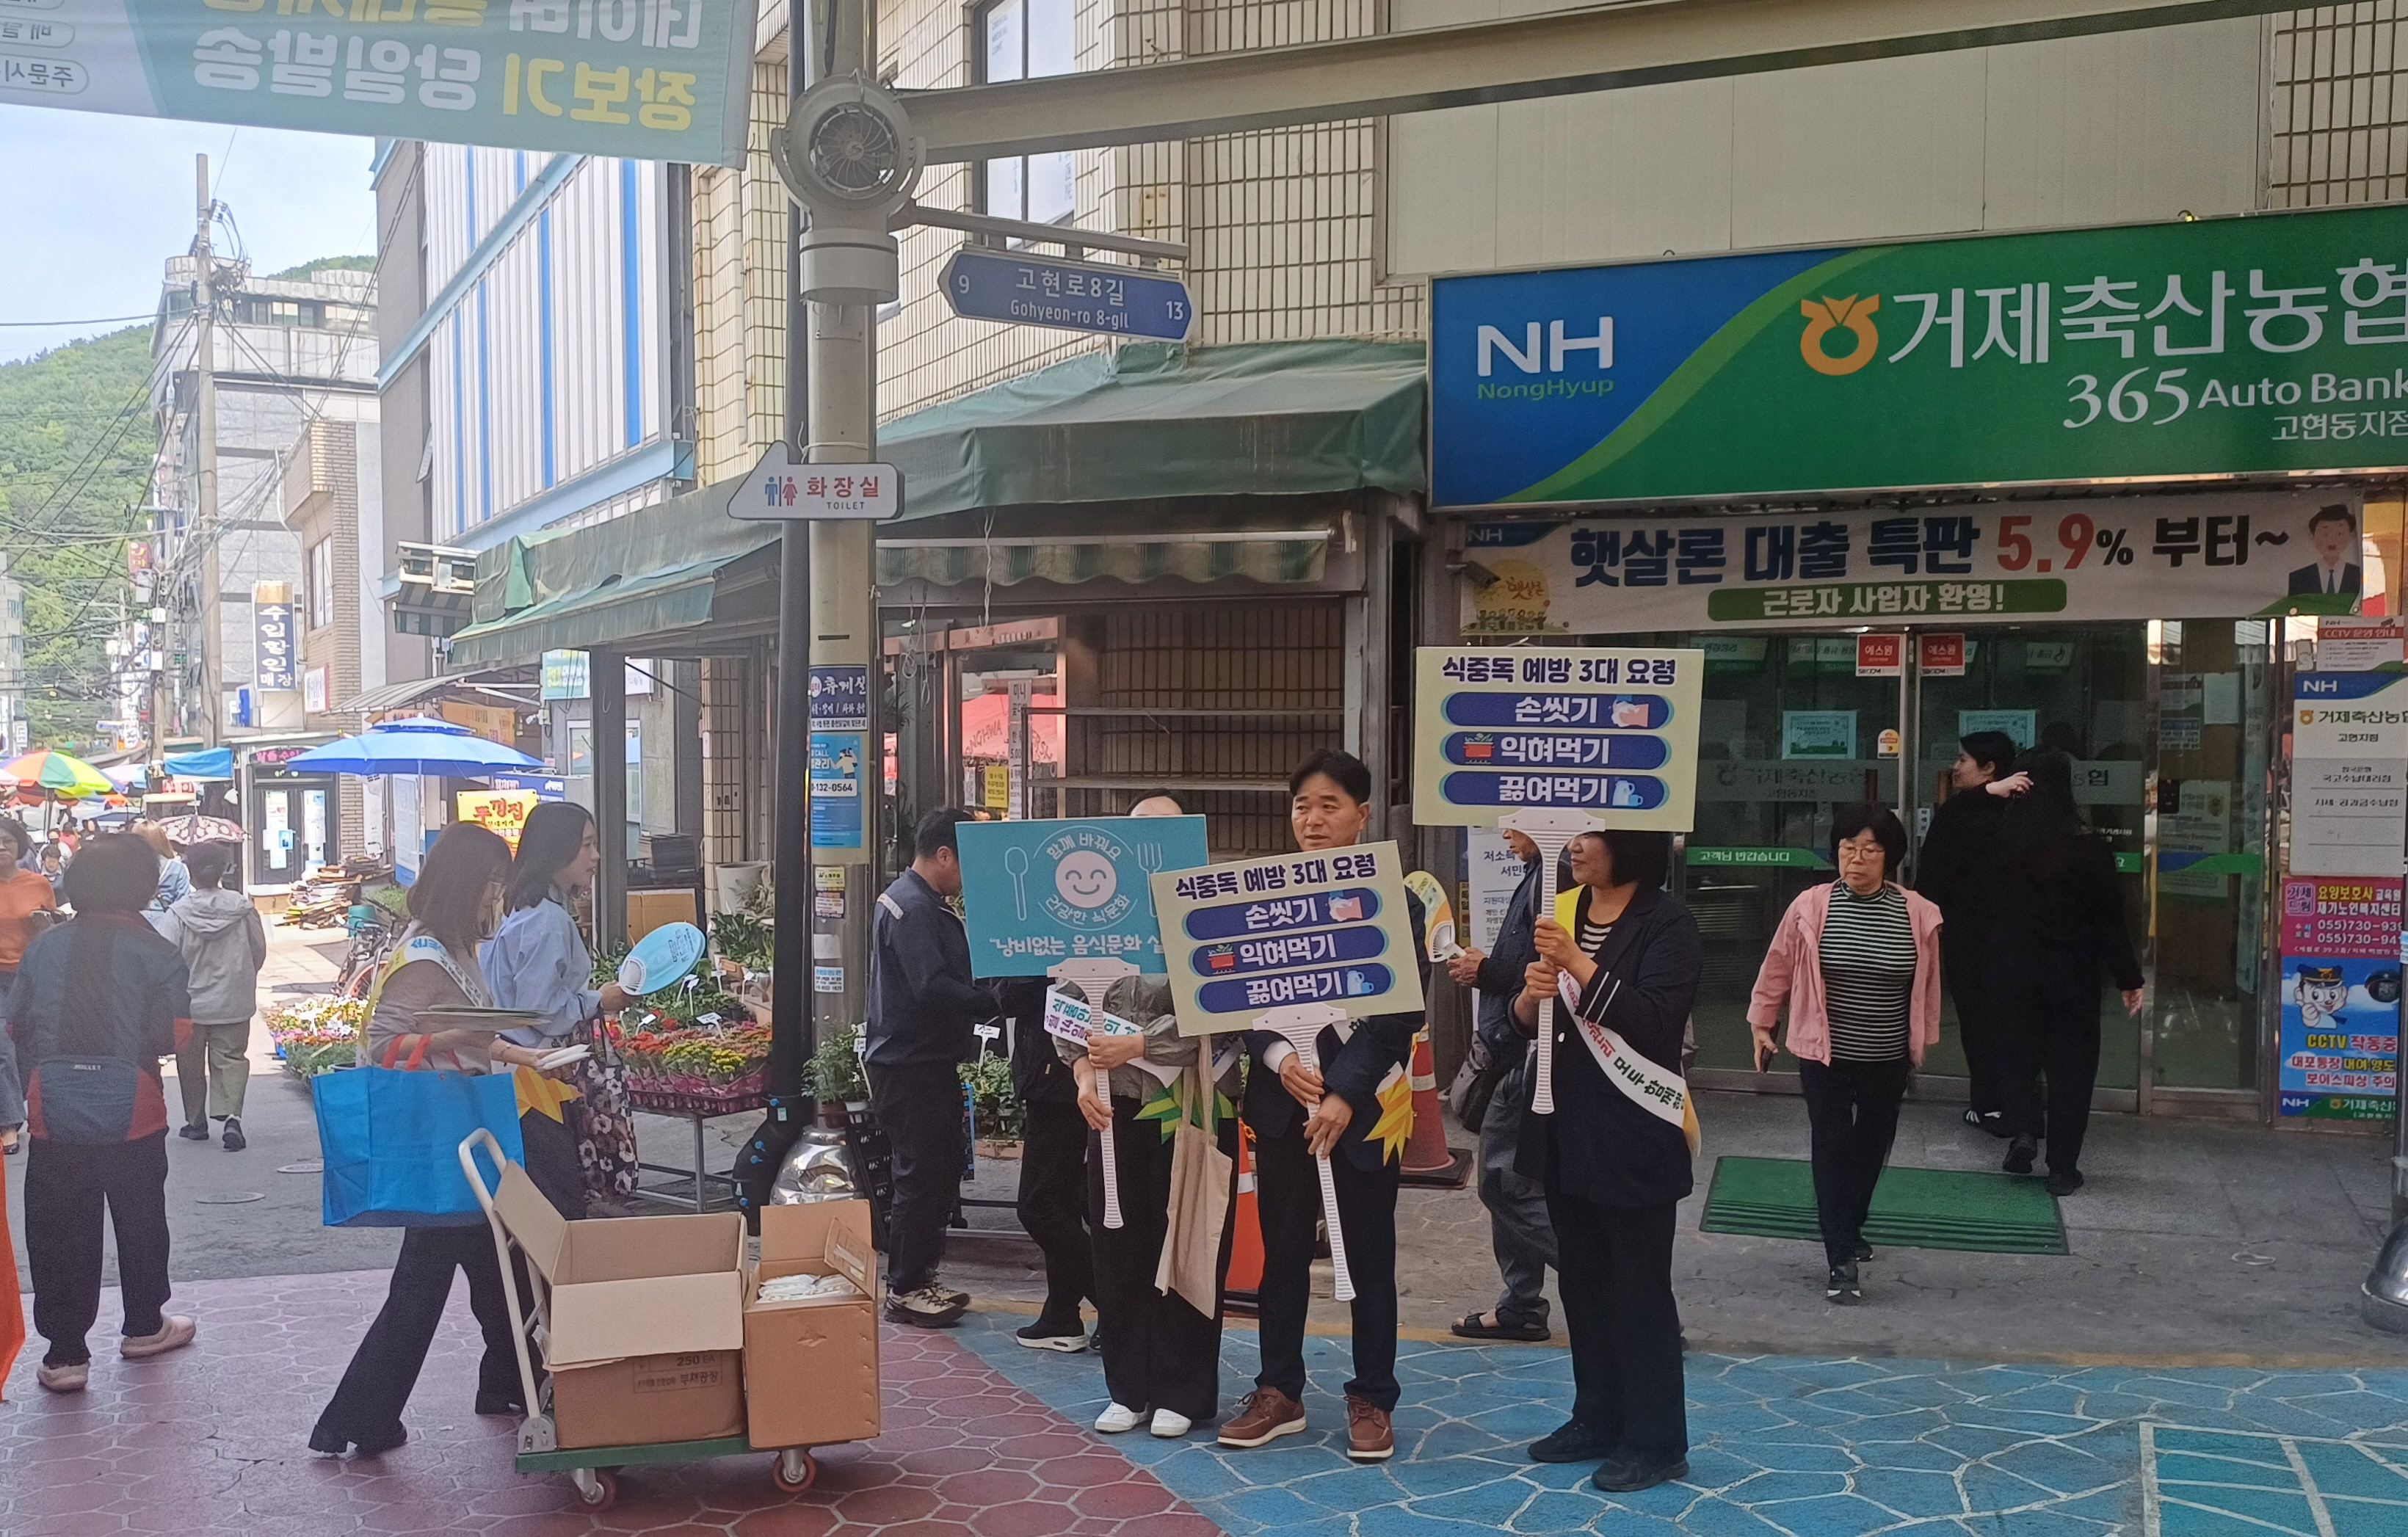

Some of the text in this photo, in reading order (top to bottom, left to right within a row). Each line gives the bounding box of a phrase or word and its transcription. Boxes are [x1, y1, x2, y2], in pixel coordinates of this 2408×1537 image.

[958, 274, 970, 294] 9
[1015, 268, 1124, 307] 고현로8길
[1010, 299, 1128, 330] Gohyeon-ro 8-gil
[1166, 301, 1183, 320] 13
[1888, 257, 2408, 369] 거제축산농협
[1478, 316, 1614, 377] NH
[1477, 378, 1614, 403] NongHyup
[2063, 367, 2408, 429] 365 Auto Bank
[807, 476, 879, 498] 화장실
[827, 501, 865, 510] TOILET
[1570, 528, 1727, 587] 햇살론
[1744, 521, 1850, 581] 대출
[1868, 516, 1981, 575] 특판
[1996, 513, 2134, 573] 5.9%
[1763, 584, 2004, 617] 근로자 사업자 환영!
[1442, 656, 1676, 686] 식중독 예방 3대 요령
[2303, 680, 2338, 692] NH
[1515, 697, 1598, 724] 손씻기
[1501, 736, 1610, 764] 익혀먹기
[1498, 775, 1608, 804] 끓여먹기
[1175, 852, 1377, 900] 식중독 예방 3대 요령
[1092, 894, 1131, 923] 식문화
[1245, 897, 1318, 930] 손씻기
[1072, 934, 1142, 956] 음식문화
[1239, 934, 1338, 967] 익혀먹기
[2318, 933, 2401, 945] 055)730-94
[1245, 971, 1343, 1006] 끓여먹기
[2307, 1034, 2398, 1053] CCTV 작동중
[2282, 1097, 2310, 1108] NH
[2343, 1099, 2396, 1111] 거제축산
[677, 1354, 716, 1367] 250 EA
